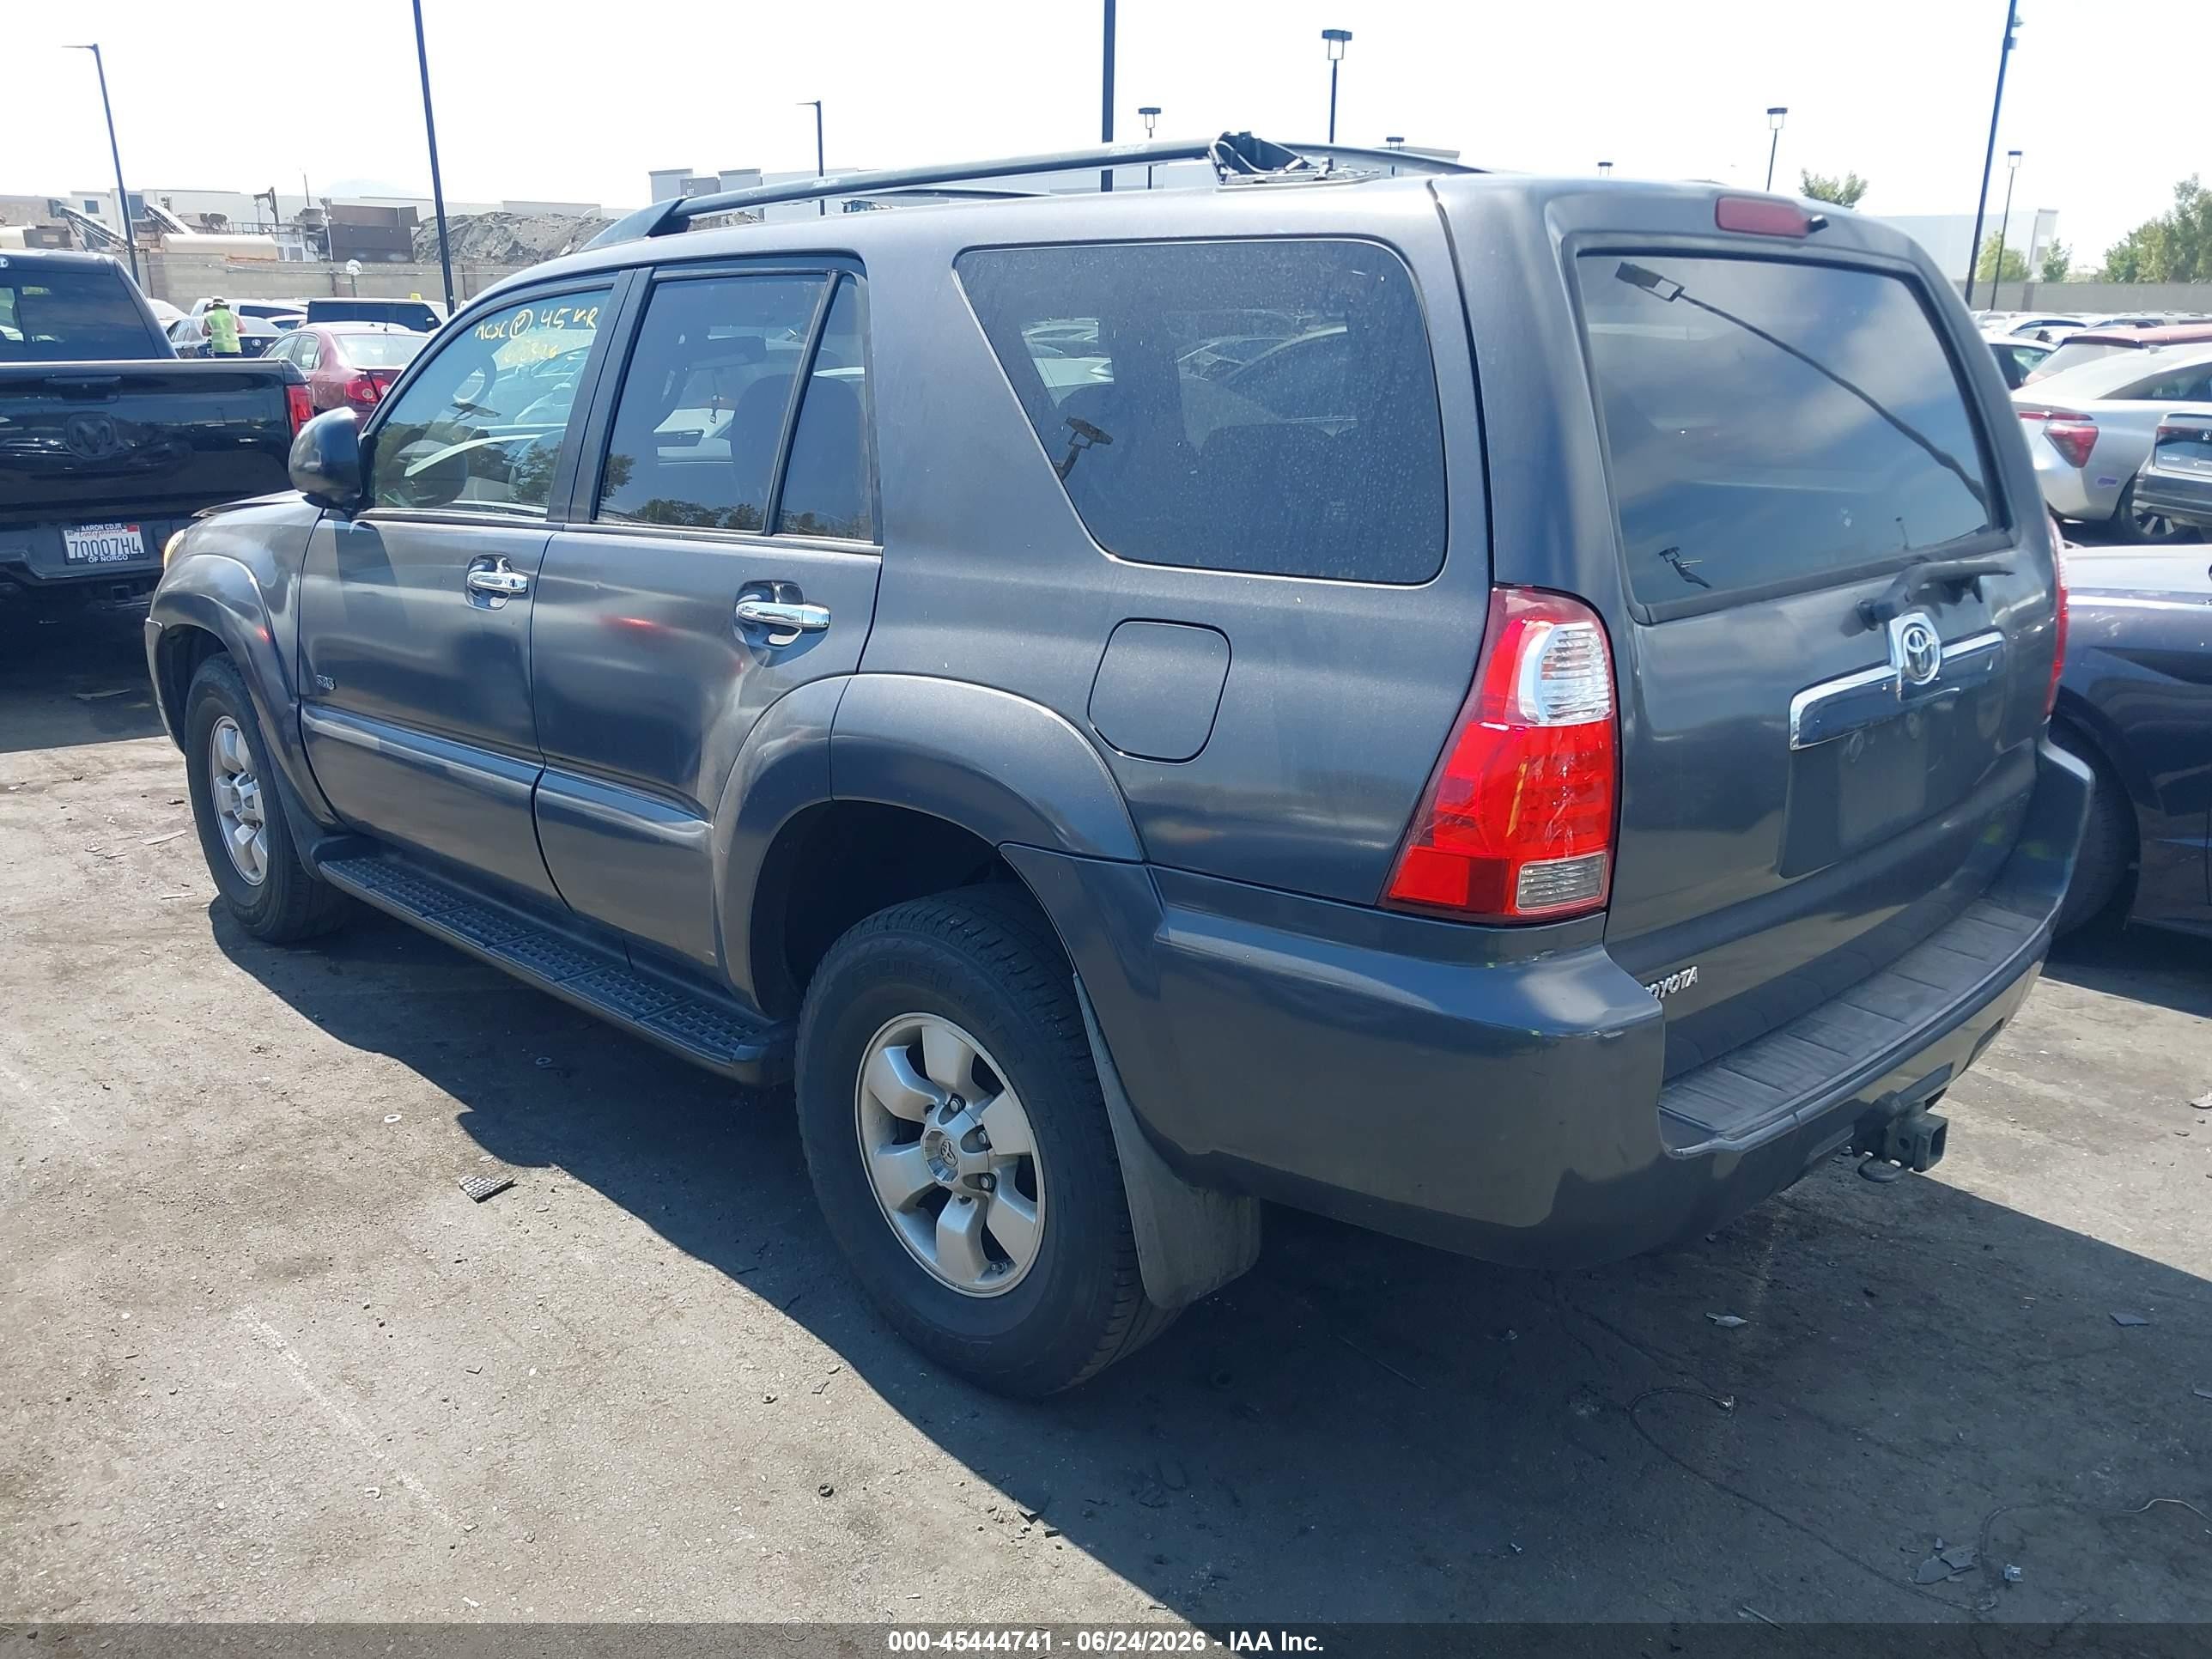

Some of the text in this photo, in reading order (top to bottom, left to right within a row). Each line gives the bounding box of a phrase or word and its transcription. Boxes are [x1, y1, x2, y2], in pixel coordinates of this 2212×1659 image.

[540, 307, 572, 329] 45
[81, 522, 122, 532] AARON CDJR
[100, 554, 129, 562] NORCO
[1644, 966, 1698, 1000] OYOTA
